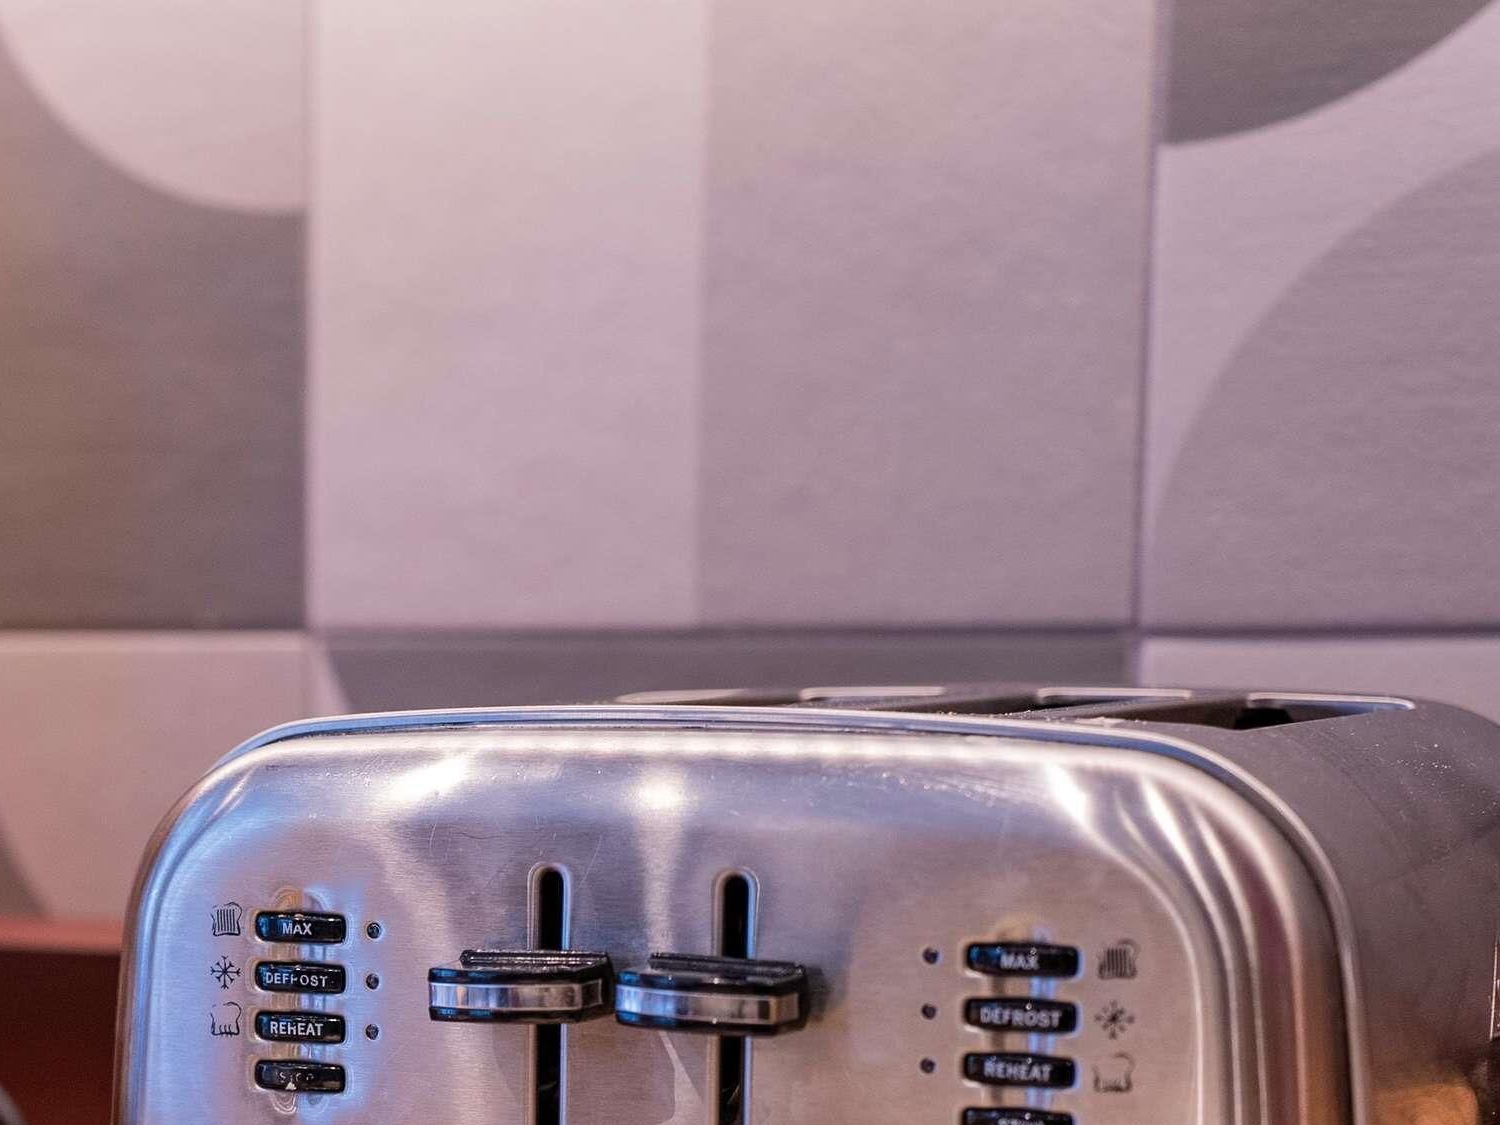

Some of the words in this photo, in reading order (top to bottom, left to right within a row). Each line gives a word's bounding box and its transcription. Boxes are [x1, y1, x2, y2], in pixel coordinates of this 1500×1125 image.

[282, 921, 313, 936] MAX
[1000, 953, 1040, 971] MAX
[979, 1007, 1063, 1029] DEFROST
[270, 1021, 324, 1037] REHEAT
[983, 1059, 1053, 1082] REHEAT
